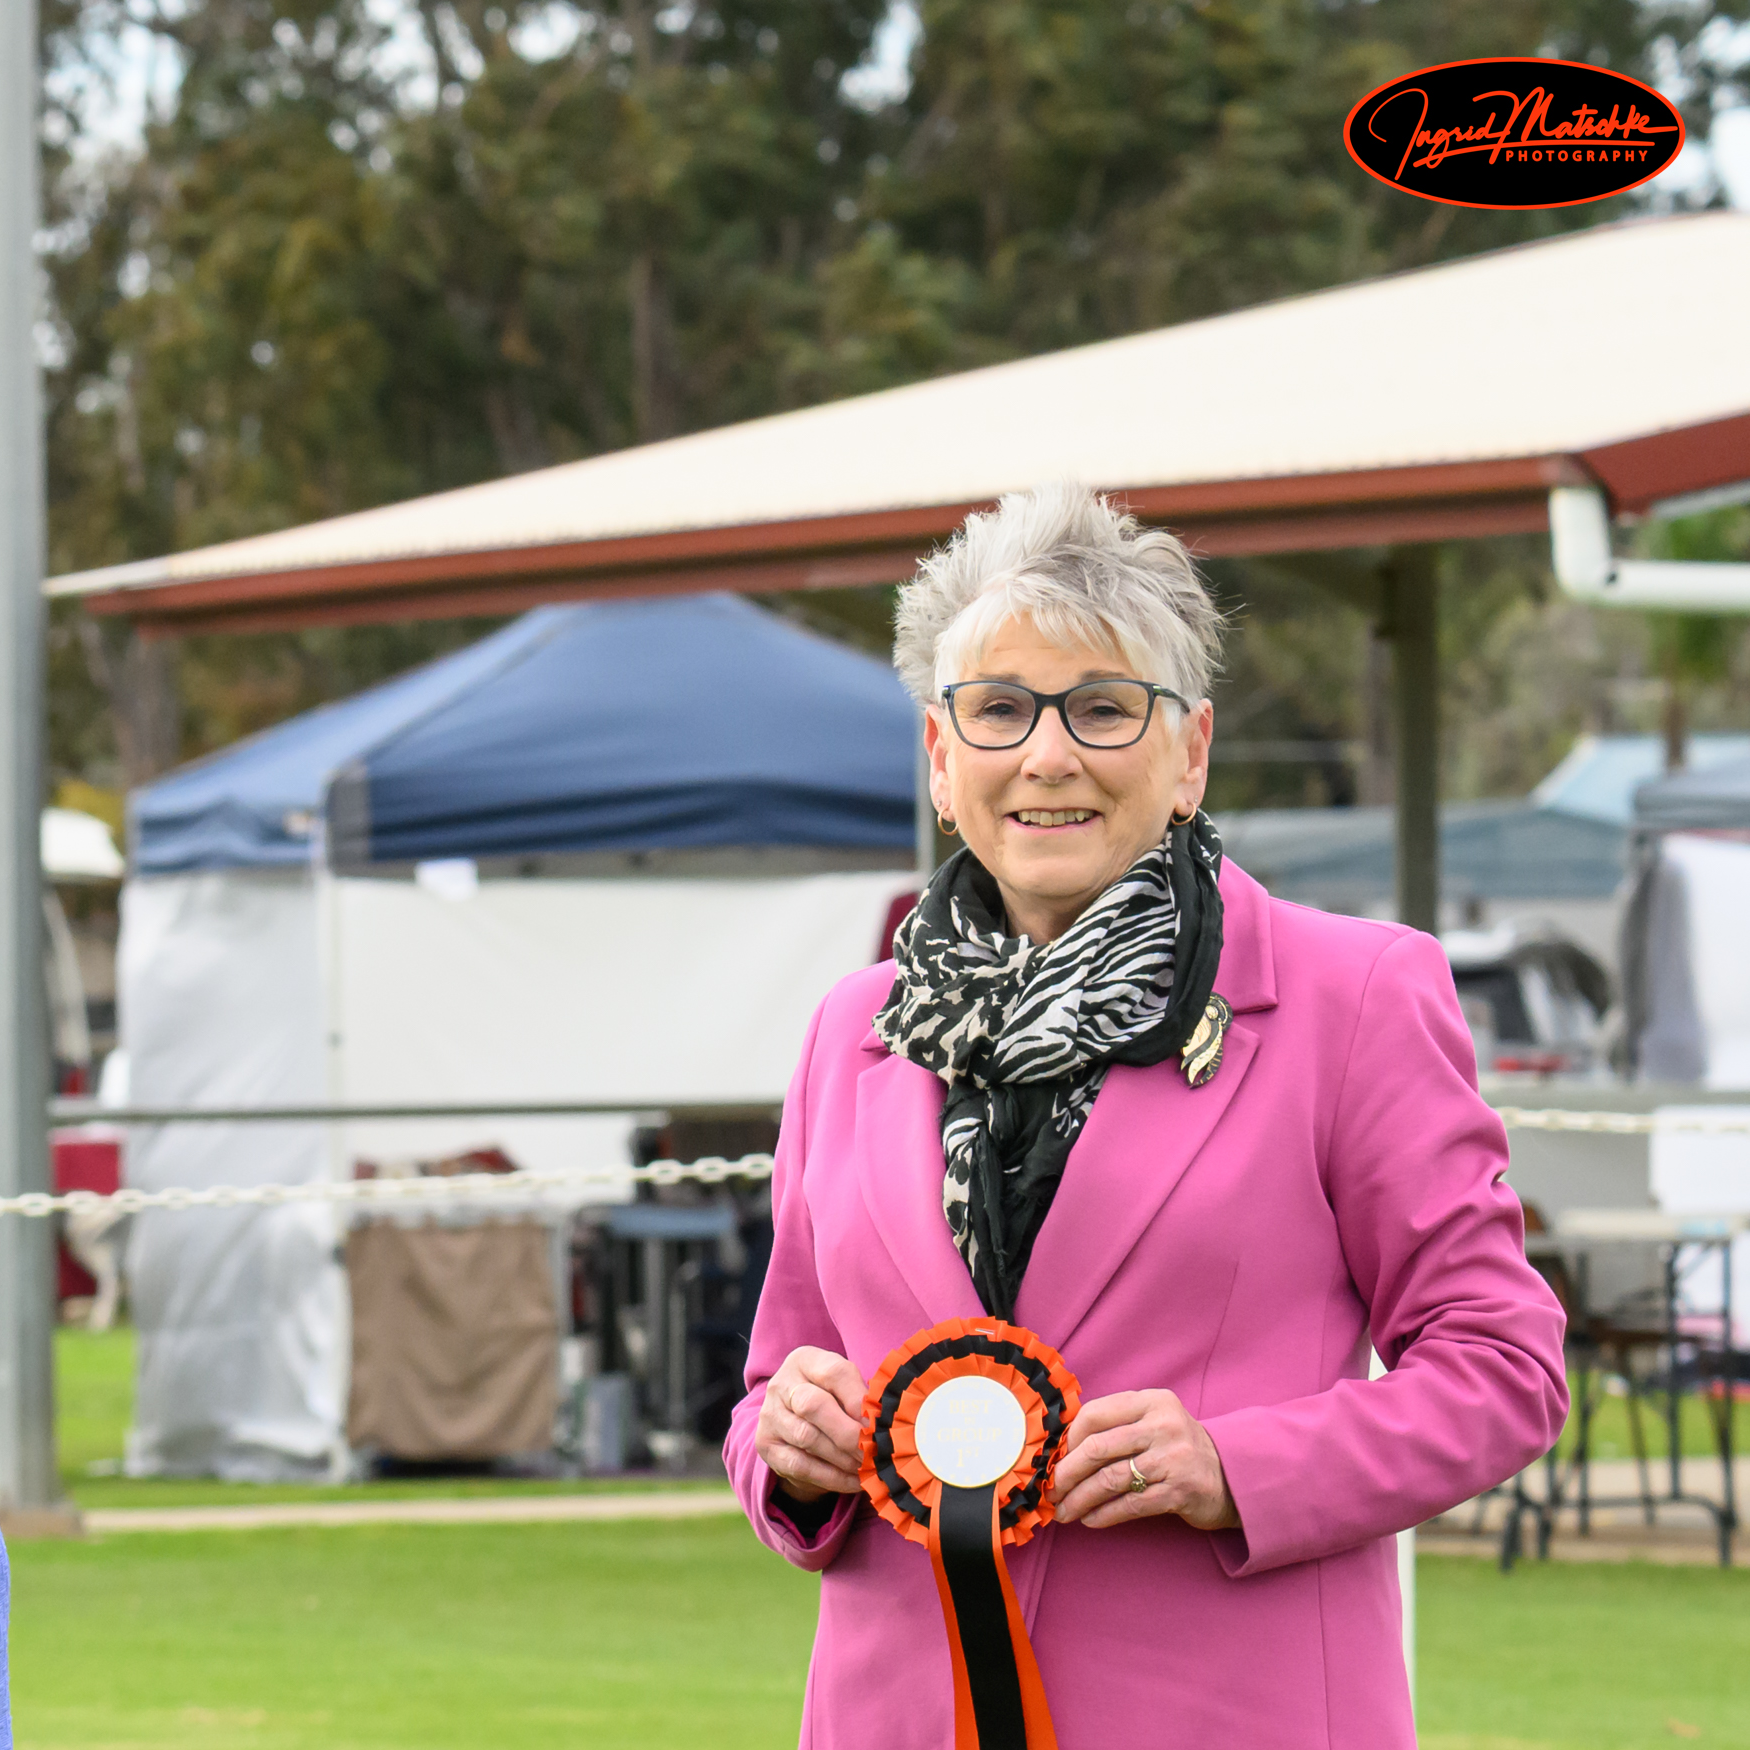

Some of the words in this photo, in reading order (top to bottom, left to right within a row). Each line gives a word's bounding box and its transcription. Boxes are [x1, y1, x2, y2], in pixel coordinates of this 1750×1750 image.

[948, 1399, 993, 1414] BEST
[937, 1427, 1003, 1443] GROUP
[956, 1446, 981, 1468] 1ST
